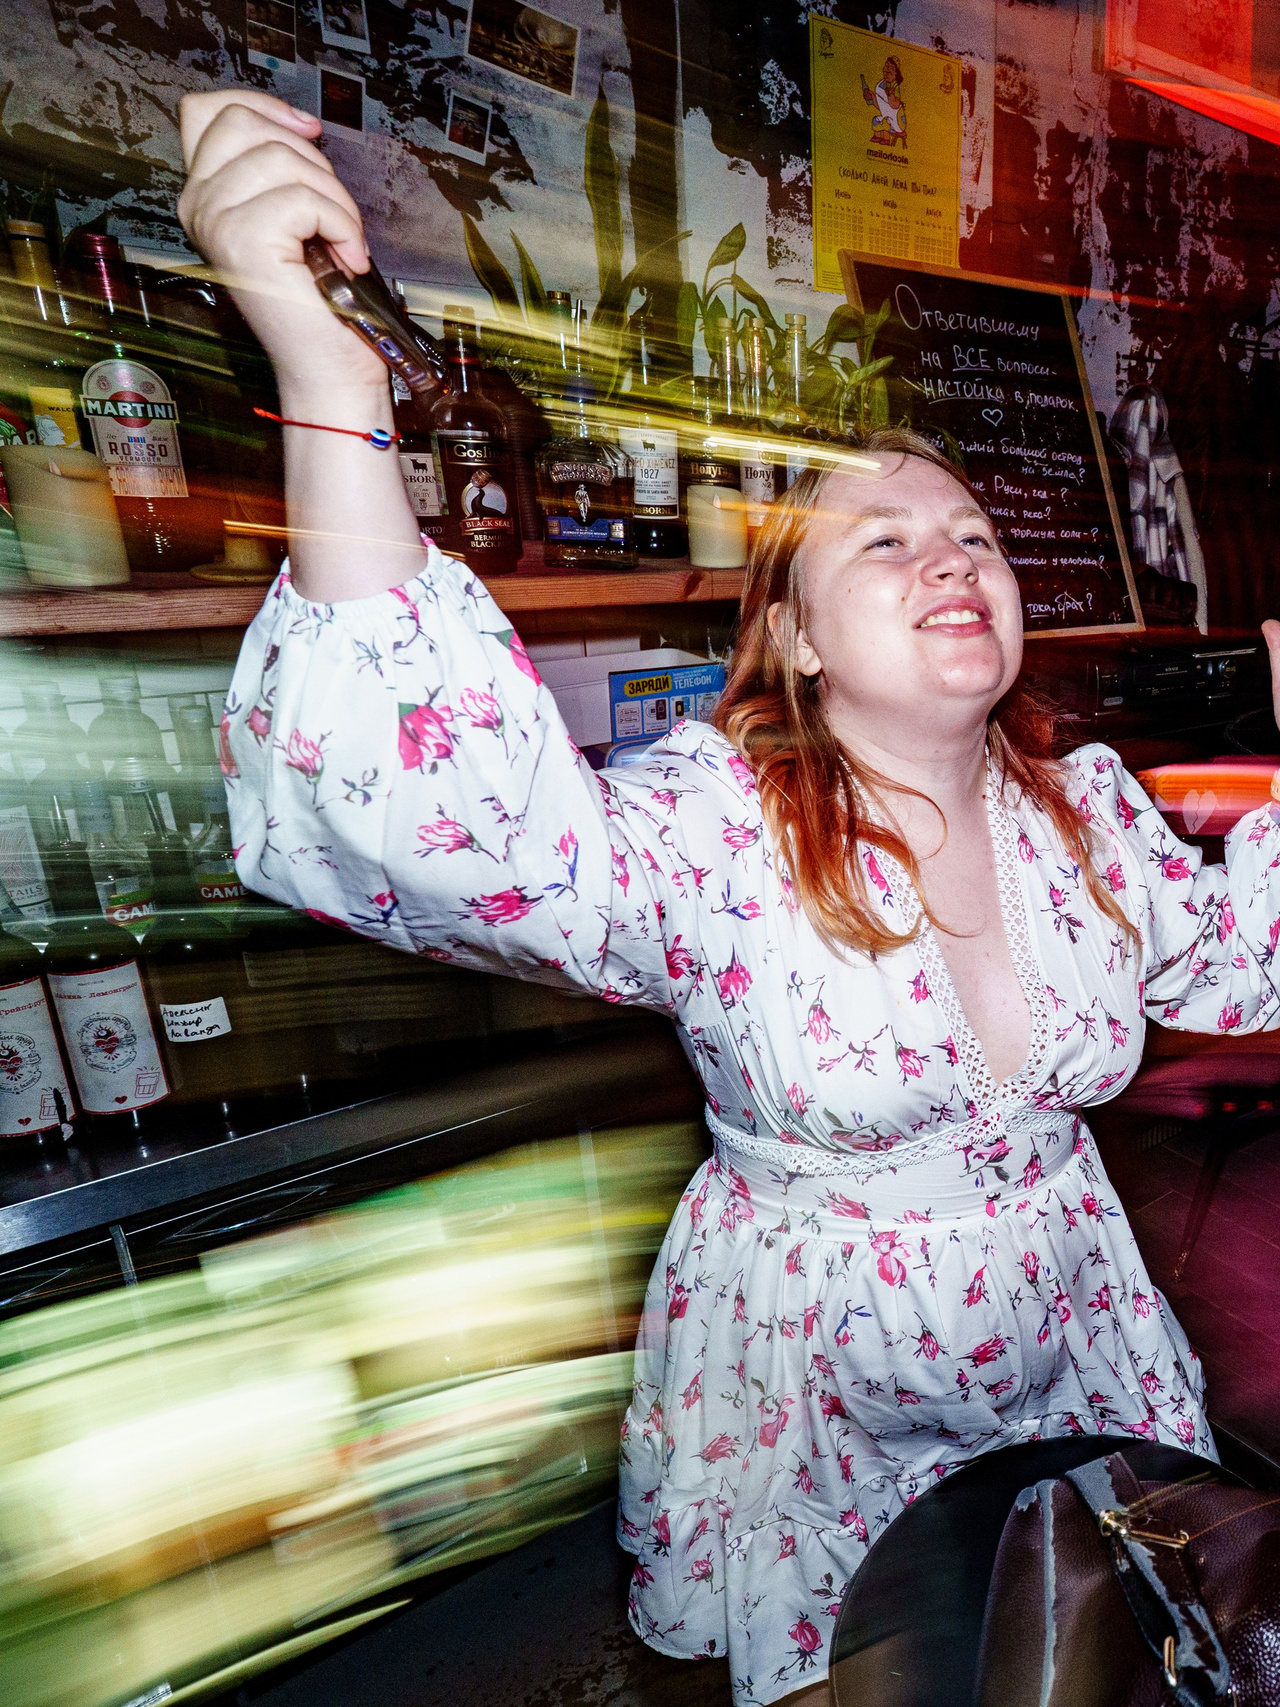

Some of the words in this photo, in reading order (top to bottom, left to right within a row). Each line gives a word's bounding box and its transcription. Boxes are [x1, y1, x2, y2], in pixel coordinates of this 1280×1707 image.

[895, 284, 1039, 341] Ответившему
[921, 351, 943, 369] на
[952, 344, 994, 372] ВСЕ
[86, 399, 174, 419] MARTINI
[109, 441, 168, 458] ROSSO
[958, 440, 994, 454] амый
[403, 474, 438, 484] SBORN
[640, 468, 660, 480] 1827
[984, 505, 1015, 518] нная
[419, 526, 443, 535] ORTO
[466, 520, 493, 529] BLACK
[494, 520, 511, 528] SEAL
[1005, 555, 1046, 566] ромосом
[627, 676, 670, 695] ЗАРЯДИ
[673, 674, 712, 690] ТЕЛЕФОН
[9, 884, 43, 898] TAILS
[112, 901, 155, 922] GAM
